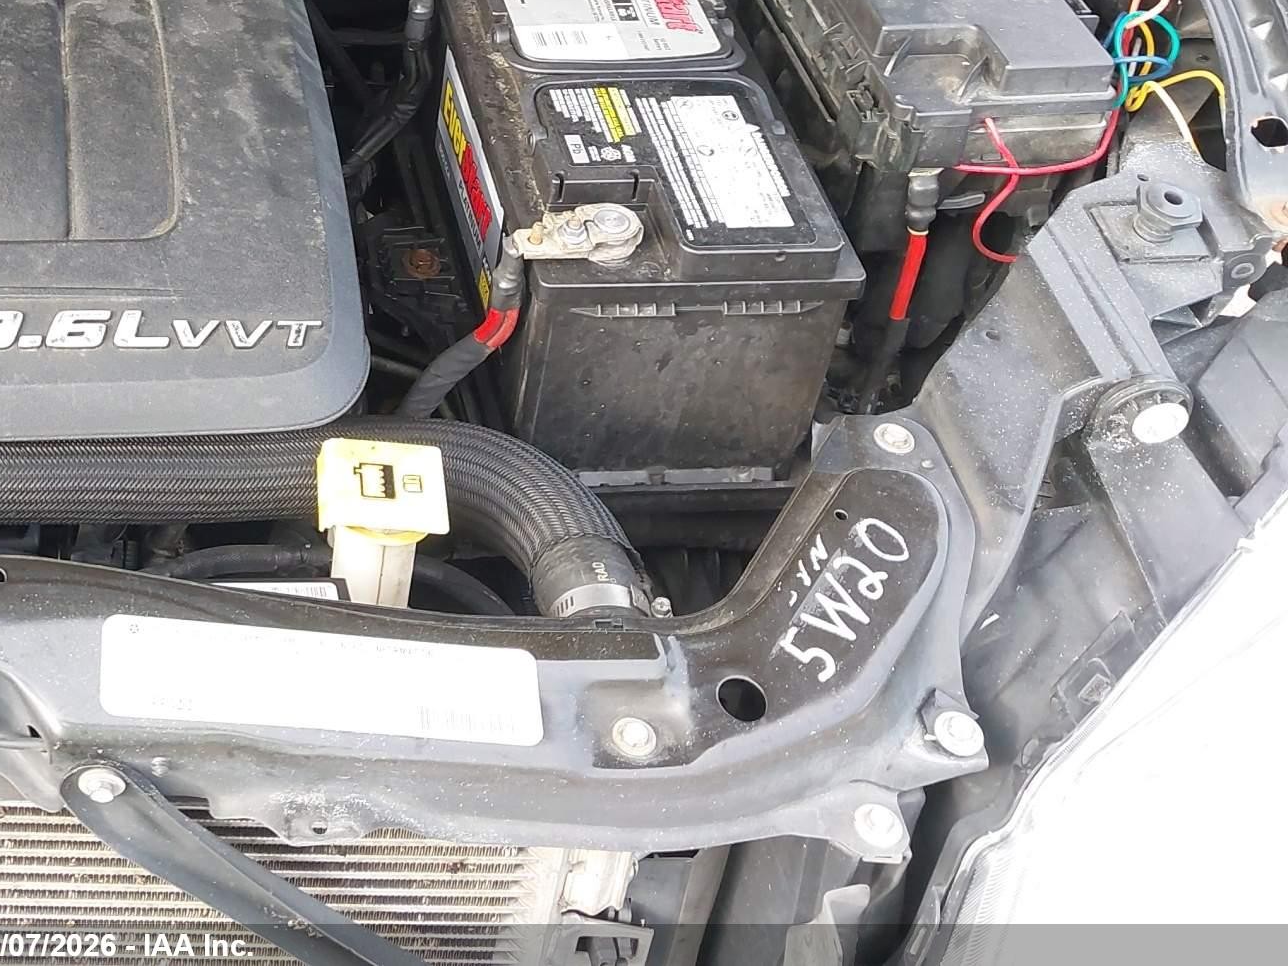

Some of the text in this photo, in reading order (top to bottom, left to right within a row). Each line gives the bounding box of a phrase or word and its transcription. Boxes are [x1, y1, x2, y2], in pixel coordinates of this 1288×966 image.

[442, 79, 493, 243] EverStart
[458, 178, 483, 251] PLATINUM
[779, 518, 910, 683] 5W20
